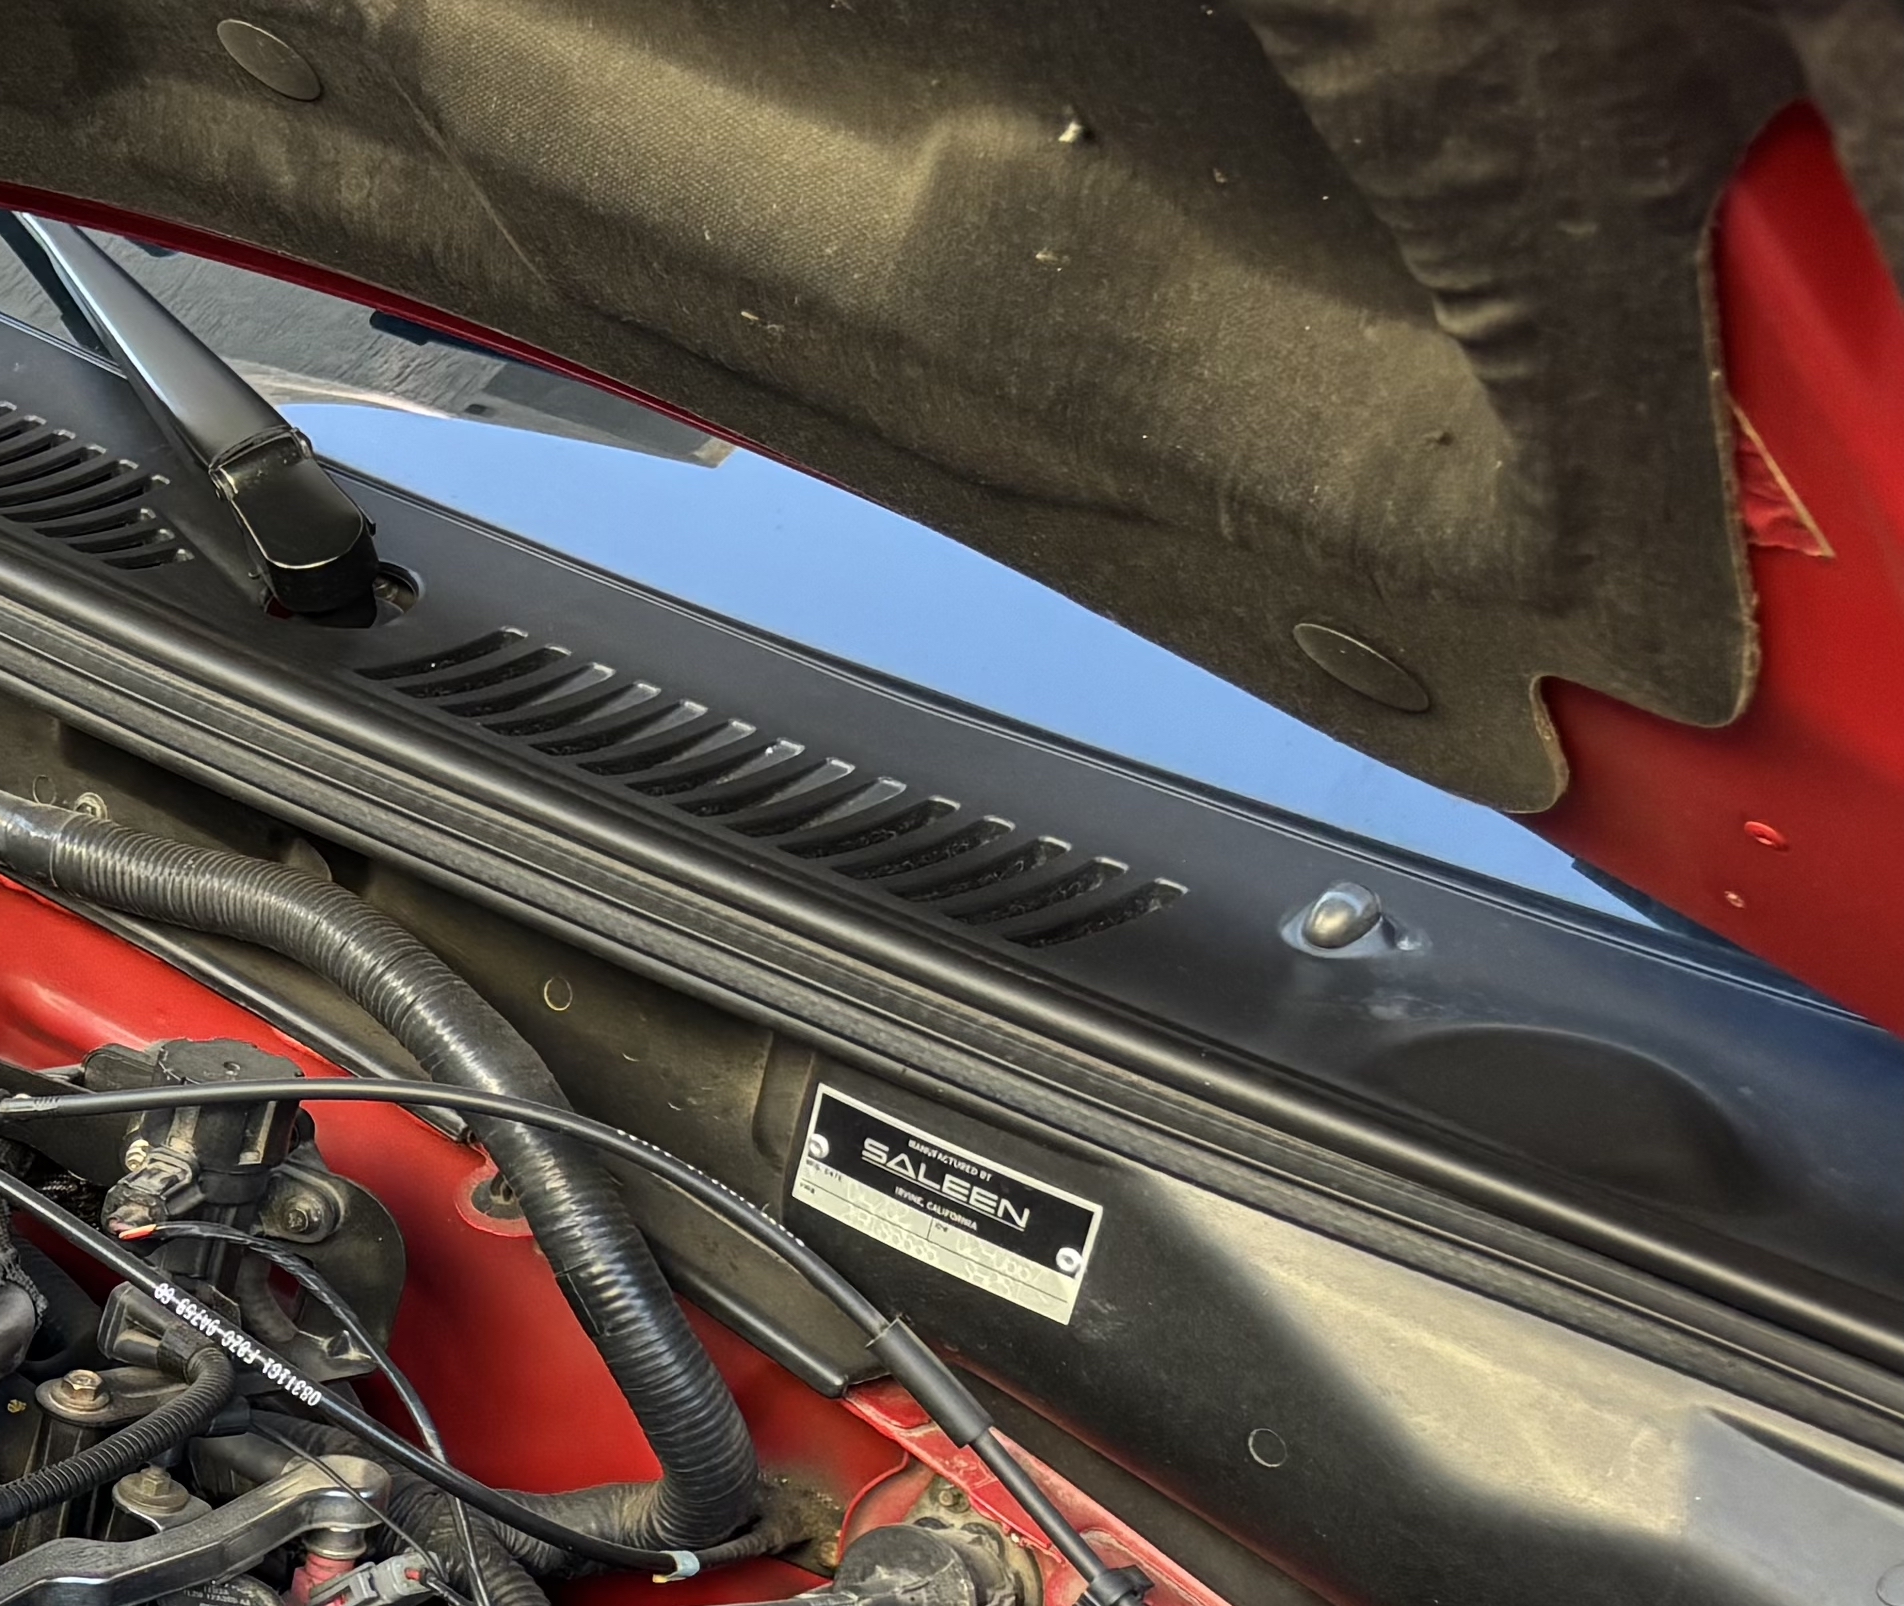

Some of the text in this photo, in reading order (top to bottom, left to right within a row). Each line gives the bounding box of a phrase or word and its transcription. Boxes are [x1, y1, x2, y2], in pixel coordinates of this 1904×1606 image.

[907, 1139, 979, 1176] MANUFACTURED
[861, 1137, 1030, 1228] SALEEN
[895, 1185, 925, 1209] IRVINE,
[925, 1199, 978, 1231] CALIFORNIA
